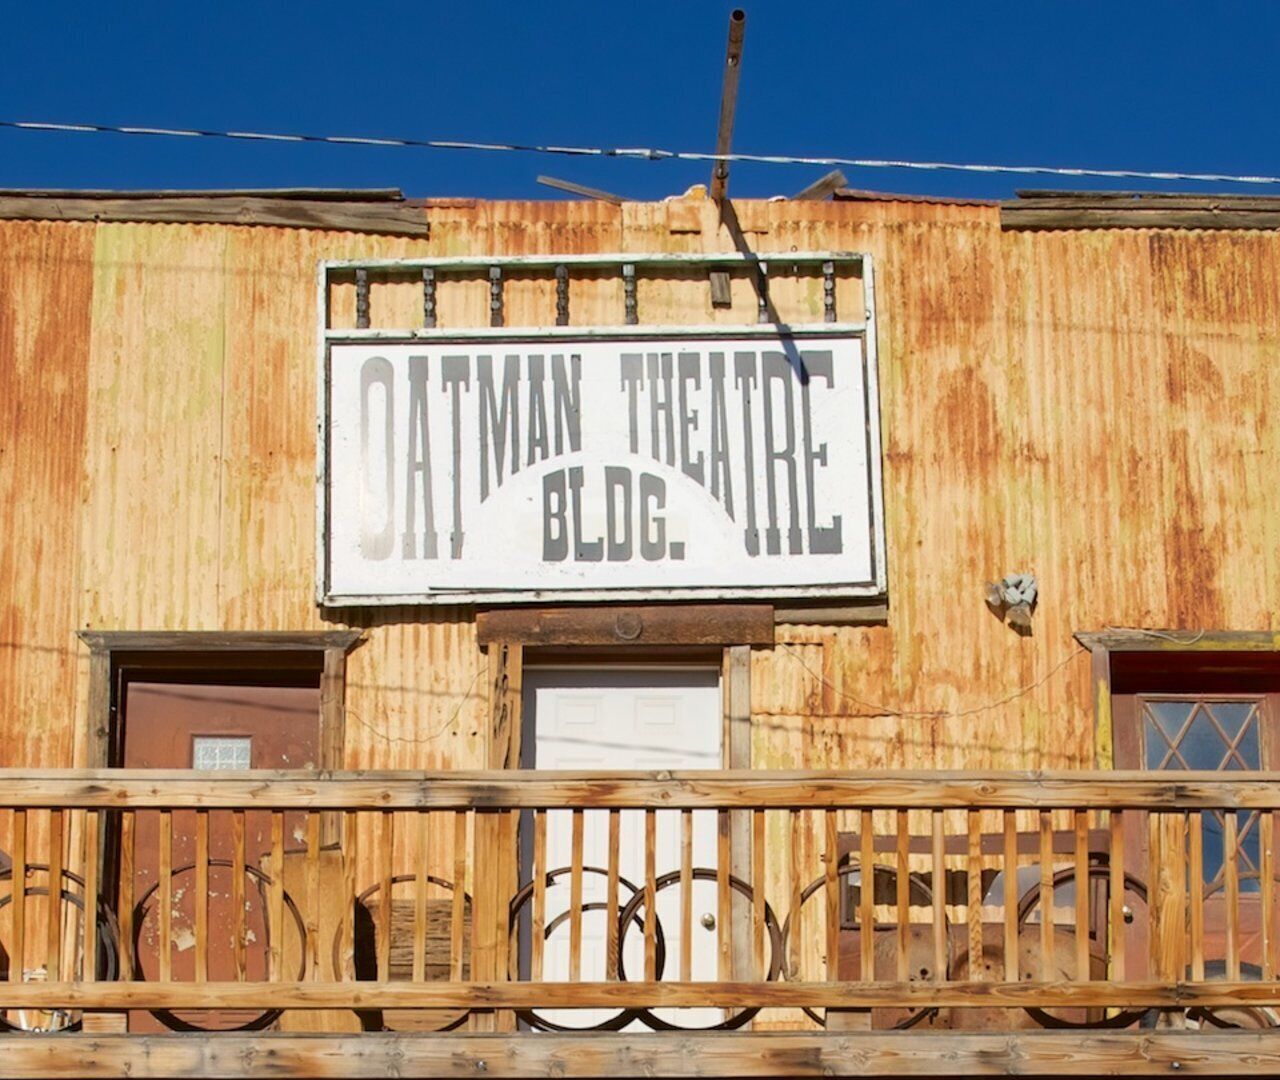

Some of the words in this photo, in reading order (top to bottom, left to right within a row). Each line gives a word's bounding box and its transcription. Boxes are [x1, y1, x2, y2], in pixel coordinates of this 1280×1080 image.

[359, 353, 583, 562] OATMAN
[620, 350, 844, 556] THEATRE
[542, 466, 687, 563] BLDG.
